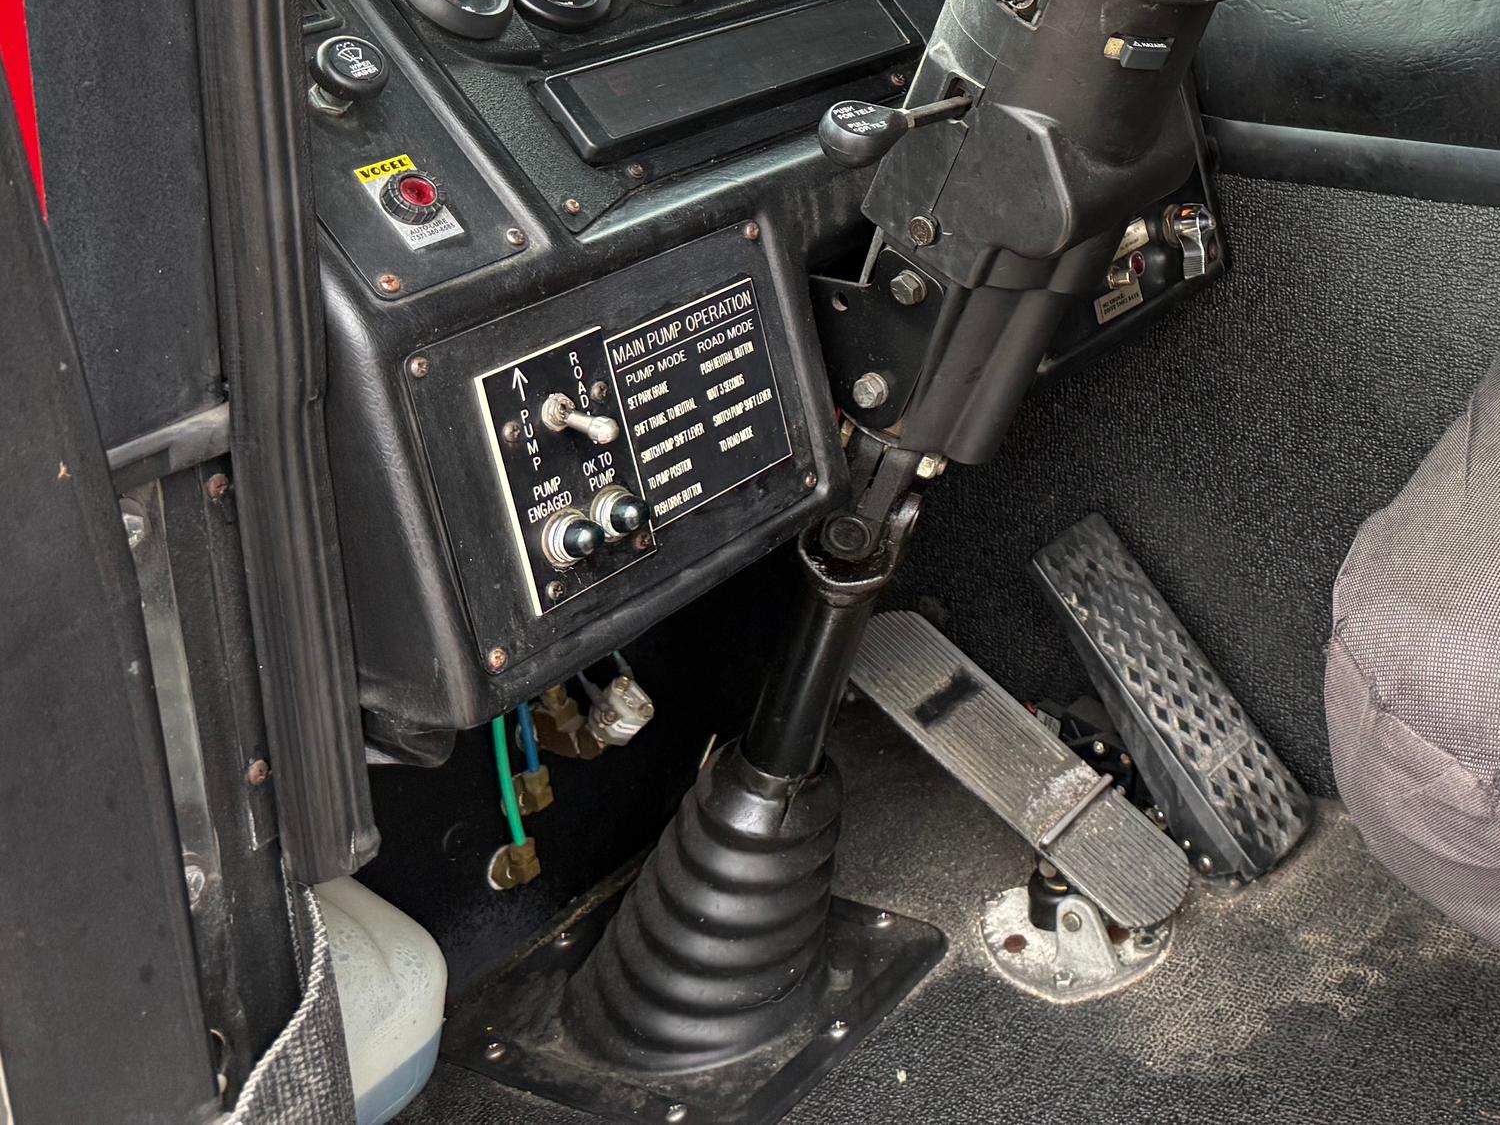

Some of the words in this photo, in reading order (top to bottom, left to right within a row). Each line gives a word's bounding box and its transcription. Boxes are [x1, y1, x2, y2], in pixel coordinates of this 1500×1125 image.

[349, 60, 372, 71] WIPER
[832, 105, 855, 115] PUSH
[837, 112, 856, 120] FOR
[854, 106, 876, 116] TELE
[847, 120, 870, 129] PULL
[870, 120, 888, 130] TILT
[359, 158, 409, 179] VOGEL
[612, 337, 646, 366] MAIN
[646, 320, 682, 350] PUMP
[685, 289, 752, 332] OPERATION
[696, 332, 725, 354] ROAD
[727, 318, 755, 340] MODE
[625, 365, 656, 387] PUMP
[657, 349, 688, 372] MODE
[700, 360, 716, 376] PUSH
[734, 340, 755, 359] BUTTON
[627, 396, 639, 410] SET
[638, 389, 653, 407] PARK
[651, 380, 670, 400] BRAKE
[712, 407, 732, 427] SWITCH
[729, 402, 745, 421] PUMP
[743, 394, 758, 412] SHIFT
[756, 387, 773, 406] LEVER
[634, 420, 650, 437] SHIFT
[666, 408, 676, 421] TO
[674, 397, 698, 417] NEUTRAL
[640, 445, 661, 464] SWITCH
[659, 437, 675, 455] PUMP
[674, 429, 688, 447] SHIFT
[686, 422, 705, 442] LEVER
[718, 439, 728, 453] TO
[740, 425, 754, 442] MODE
[582, 458, 598, 476] OK
[600, 451, 613, 468] TO
[648, 476, 657, 490] TO
[655, 468, 672, 487] PUMP
[670, 458, 693, 479] POSITION
[533, 475, 562, 501] PUMP
[589, 467, 616, 492] PUMP
[527, 490, 573, 524] ENGAGED
[653, 499, 670, 517] PUSH
[668, 491, 683, 510] DRIVE
[682, 481, 703, 503] BUTTON
